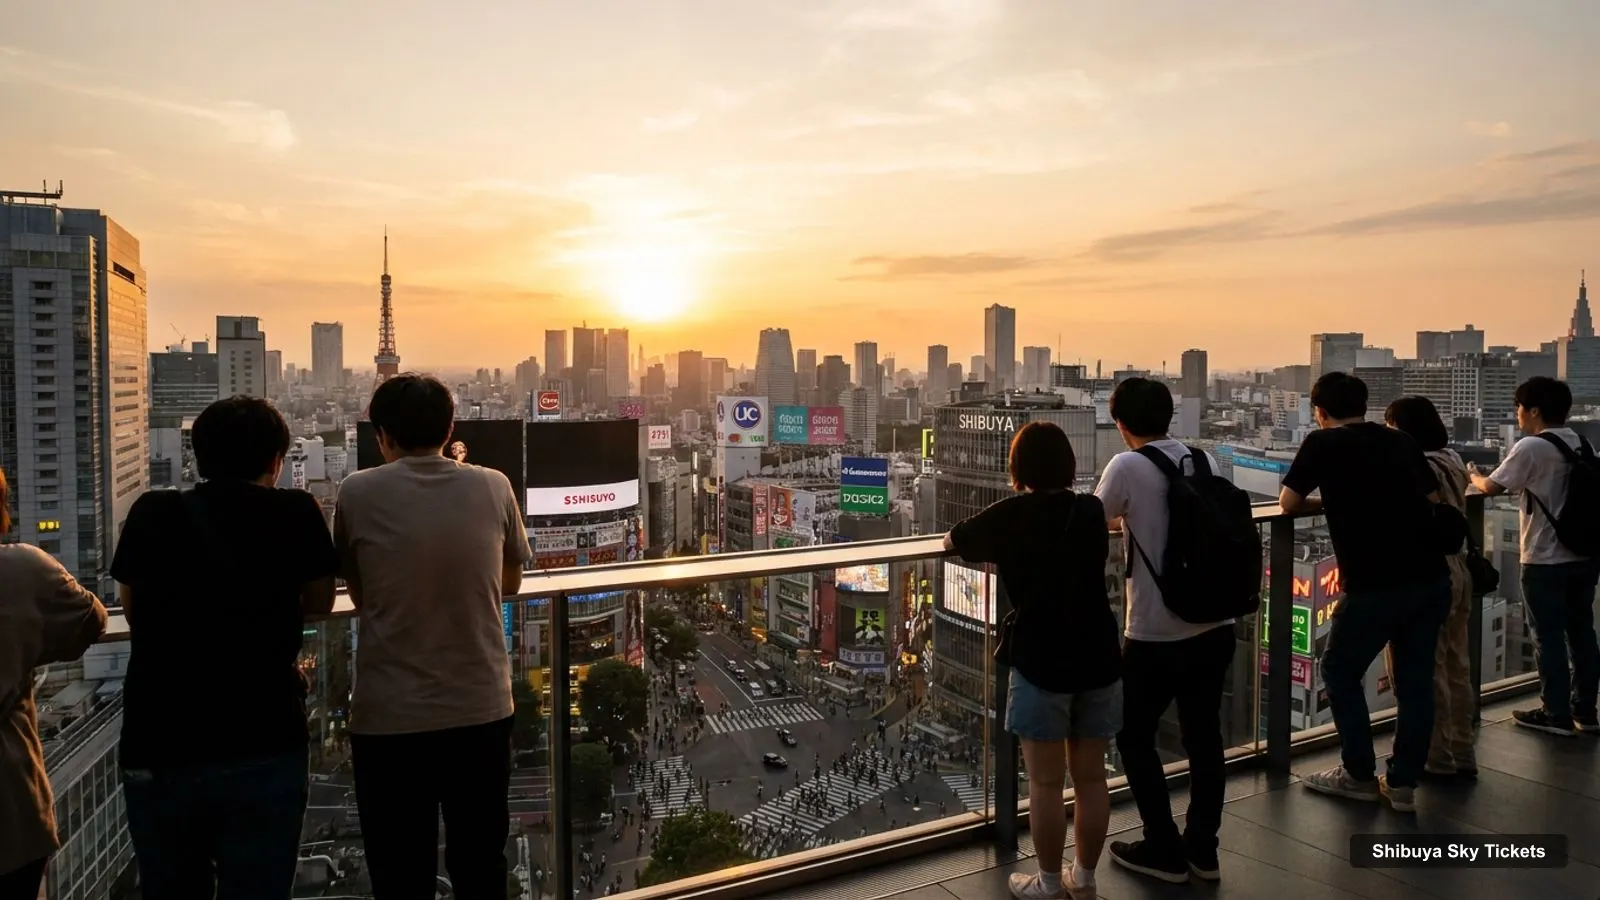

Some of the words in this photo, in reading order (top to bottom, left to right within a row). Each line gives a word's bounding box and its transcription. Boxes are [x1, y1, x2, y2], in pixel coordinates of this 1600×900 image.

[735, 406, 758, 421] UC
[959, 413, 1014, 432] SHIBUYA
[564, 493, 616, 505] SSHISUYO
